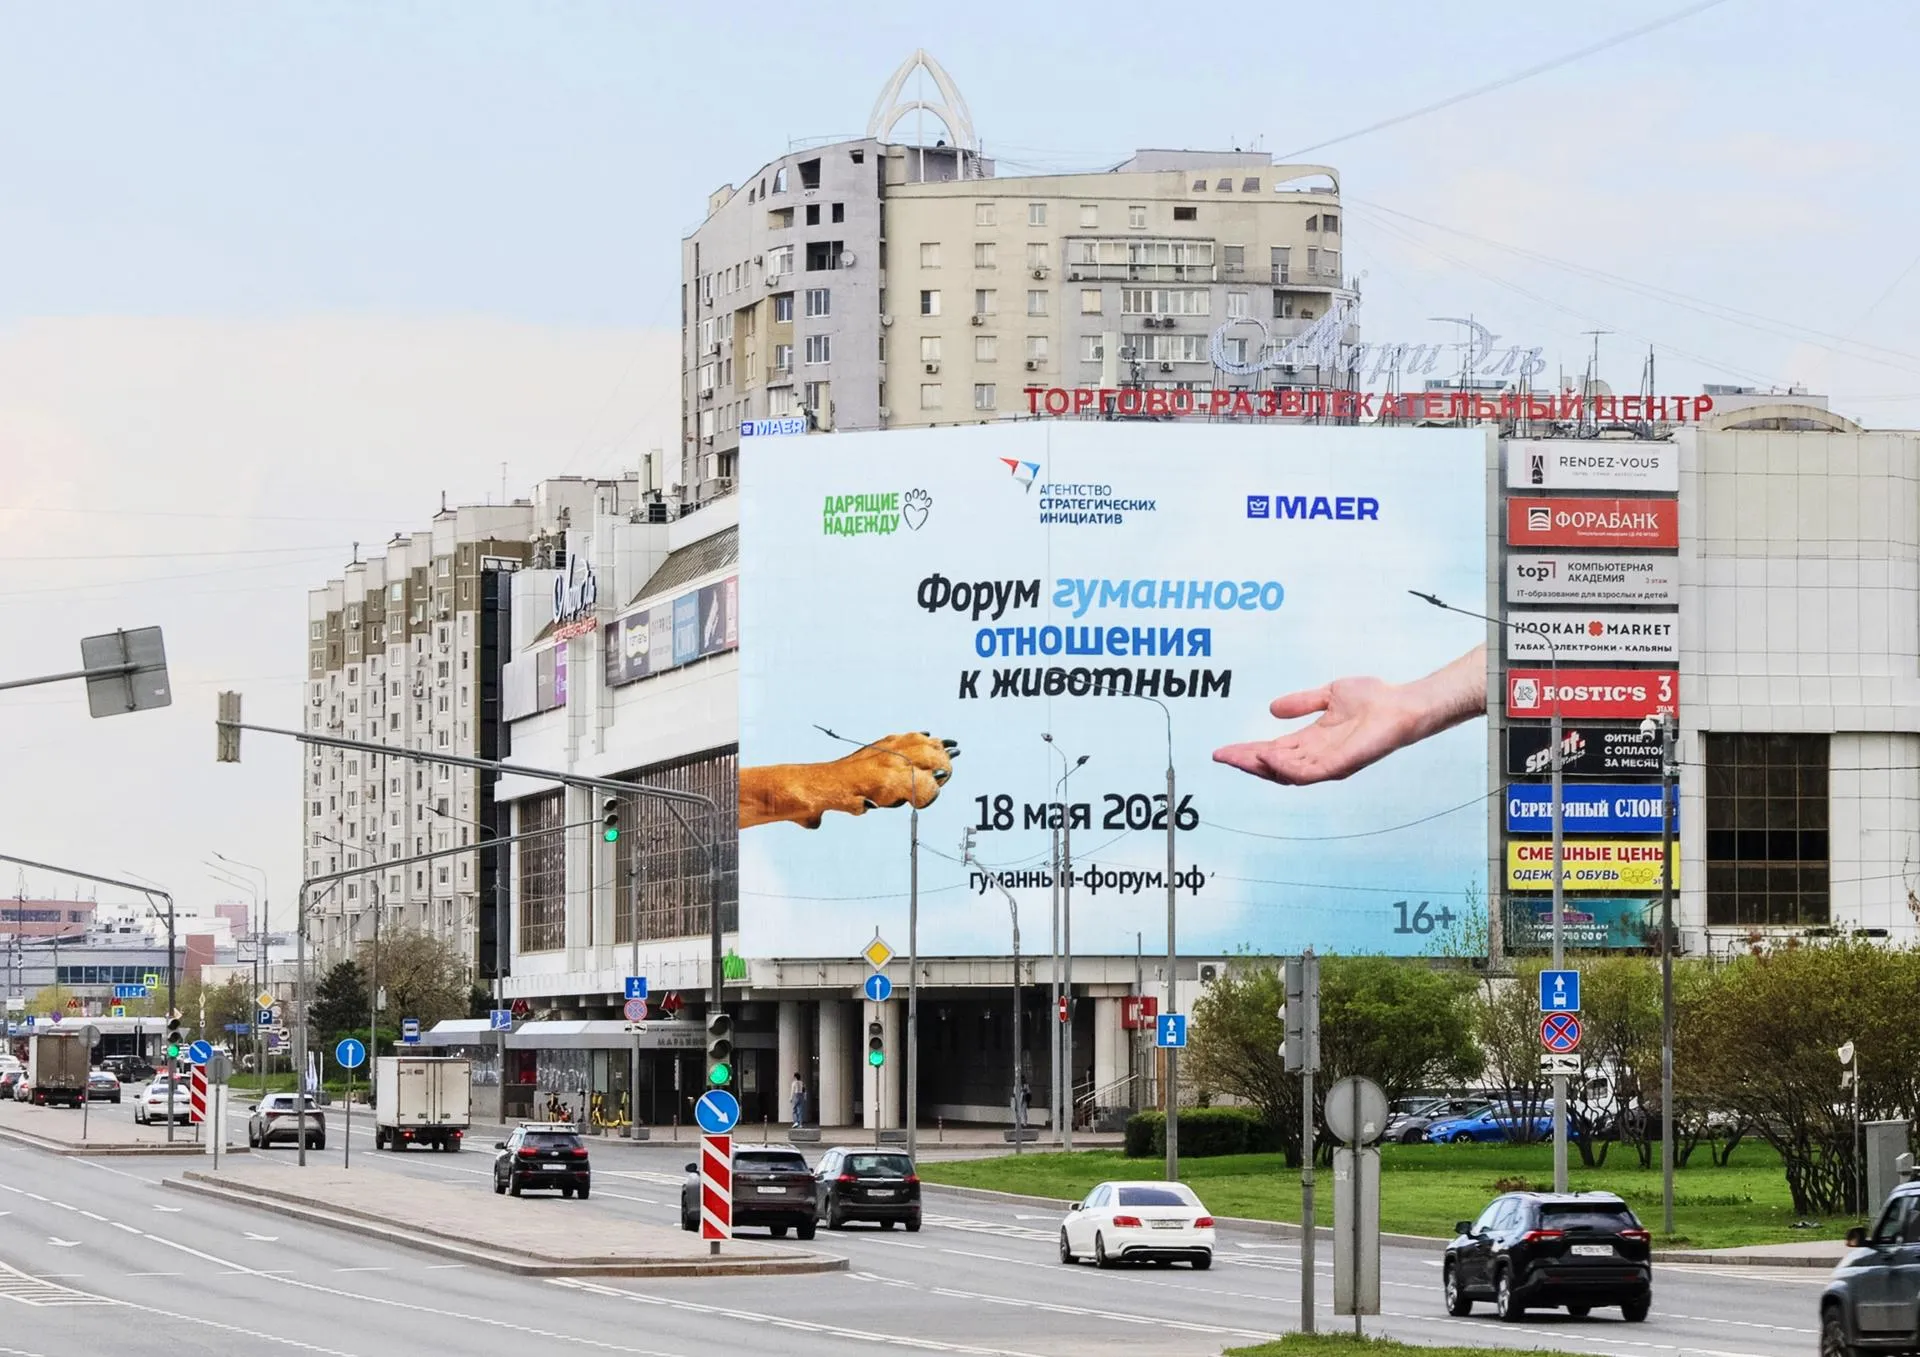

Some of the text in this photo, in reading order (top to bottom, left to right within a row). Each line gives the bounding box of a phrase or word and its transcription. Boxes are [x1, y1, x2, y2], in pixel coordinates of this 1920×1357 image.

[1023, 387, 1714, 424] ТОРГОВО-РАЗВЛЕКАТЕЛЬНЫЙ ЦЕНТР
[757, 419, 806, 436] MAER
[1559, 456, 1660, 469] RENDEZ-VOUS
[1040, 484, 1112, 497] АГЕНТСТВО
[823, 493, 900, 517] ДАРЯЩИЕ
[1039, 498, 1156, 511] СТРАТЕГИЧЕСКИХ
[1275, 496, 1380, 521] MAER
[823, 515, 900, 537] НАДЕЖДУ
[1040, 512, 1123, 525] ИНИЦИАТИВ
[1555, 511, 1659, 529] ФОРАБАНК
[1517, 564, 1549, 581] top
[1567, 562, 1653, 572] КОМПЬЮТЕРНАЯ
[1567, 573, 1625, 583] АКАДЕМИЯ
[917, 573, 1285, 621] Форум гуманного
[1597, 591, 1636, 600] взрослых
[1606, 624, 1671, 636] MARKET
[975, 625, 1212, 658] отношения
[959, 666, 1232, 699] к животным
[1657, 675, 1672, 702] 3
[1543, 686, 1647, 701] ROSTIC'S
[1604, 733, 1651, 743] ФИТНЕ
[1604, 759, 1659, 768] ЗА МЕСЯЦ
[975, 793, 1200, 831] 18 мая 2026
[1513, 869, 1619, 881] ОДЕЖА ОБУВЬ
[1393, 901, 1457, 934] 16+
